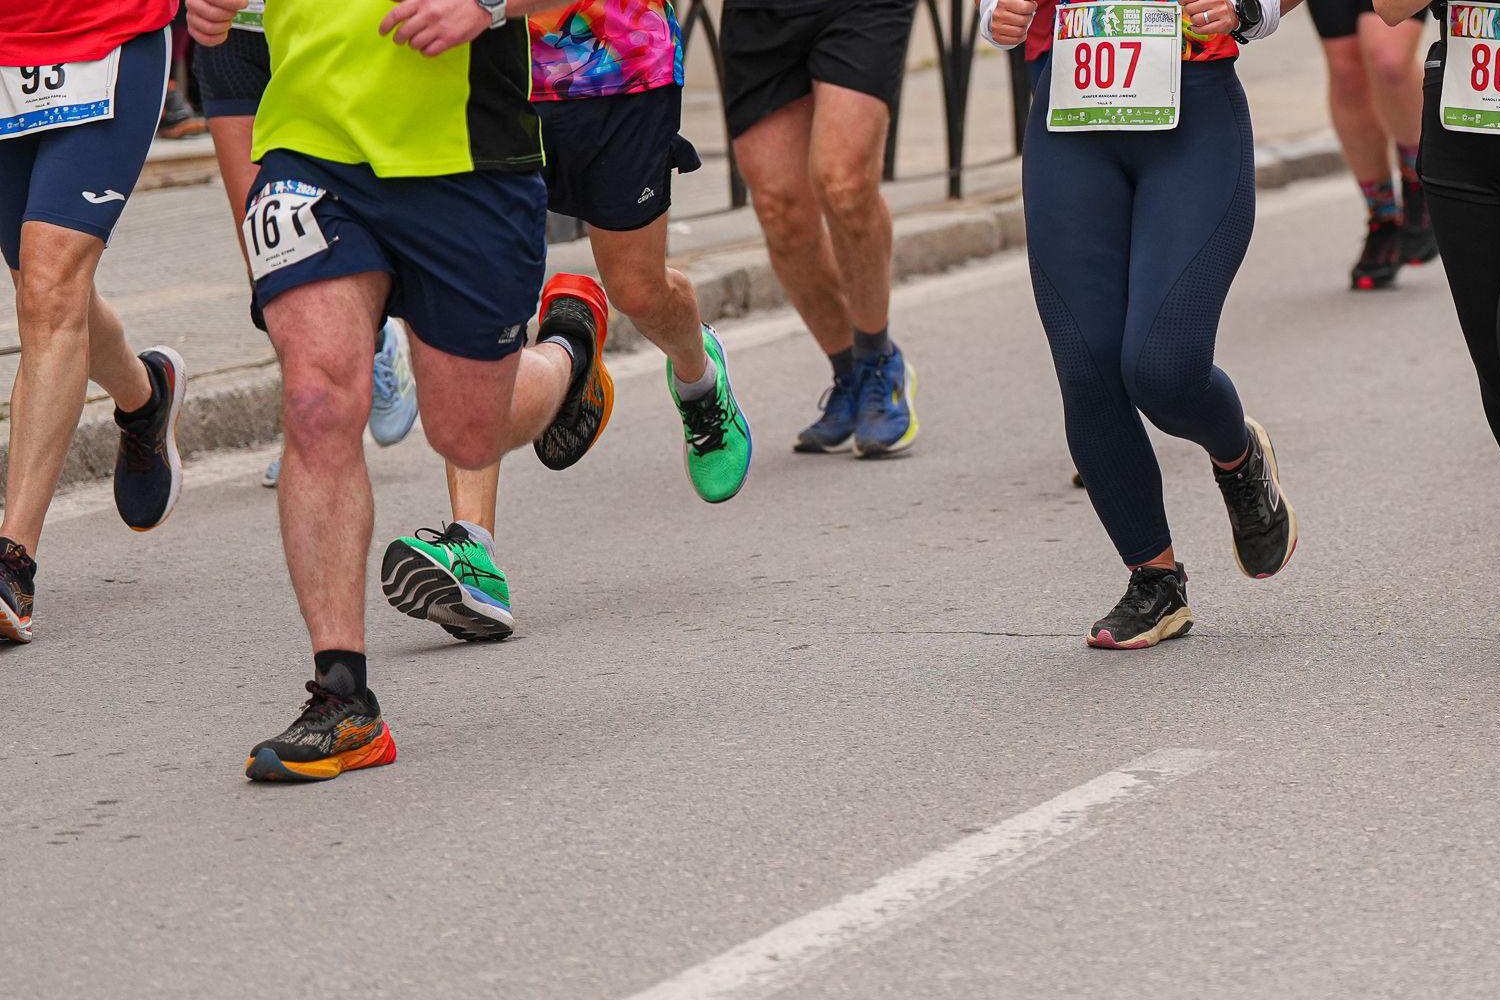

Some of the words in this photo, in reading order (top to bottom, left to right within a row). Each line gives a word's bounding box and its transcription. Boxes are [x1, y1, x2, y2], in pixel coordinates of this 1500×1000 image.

[1065, 8, 1095, 37] 10K
[1123, 24, 1140, 34] 2026
[1459, 7, 1496, 38] 10K
[20, 63, 65, 95] 93
[1074, 41, 1142, 90] 807
